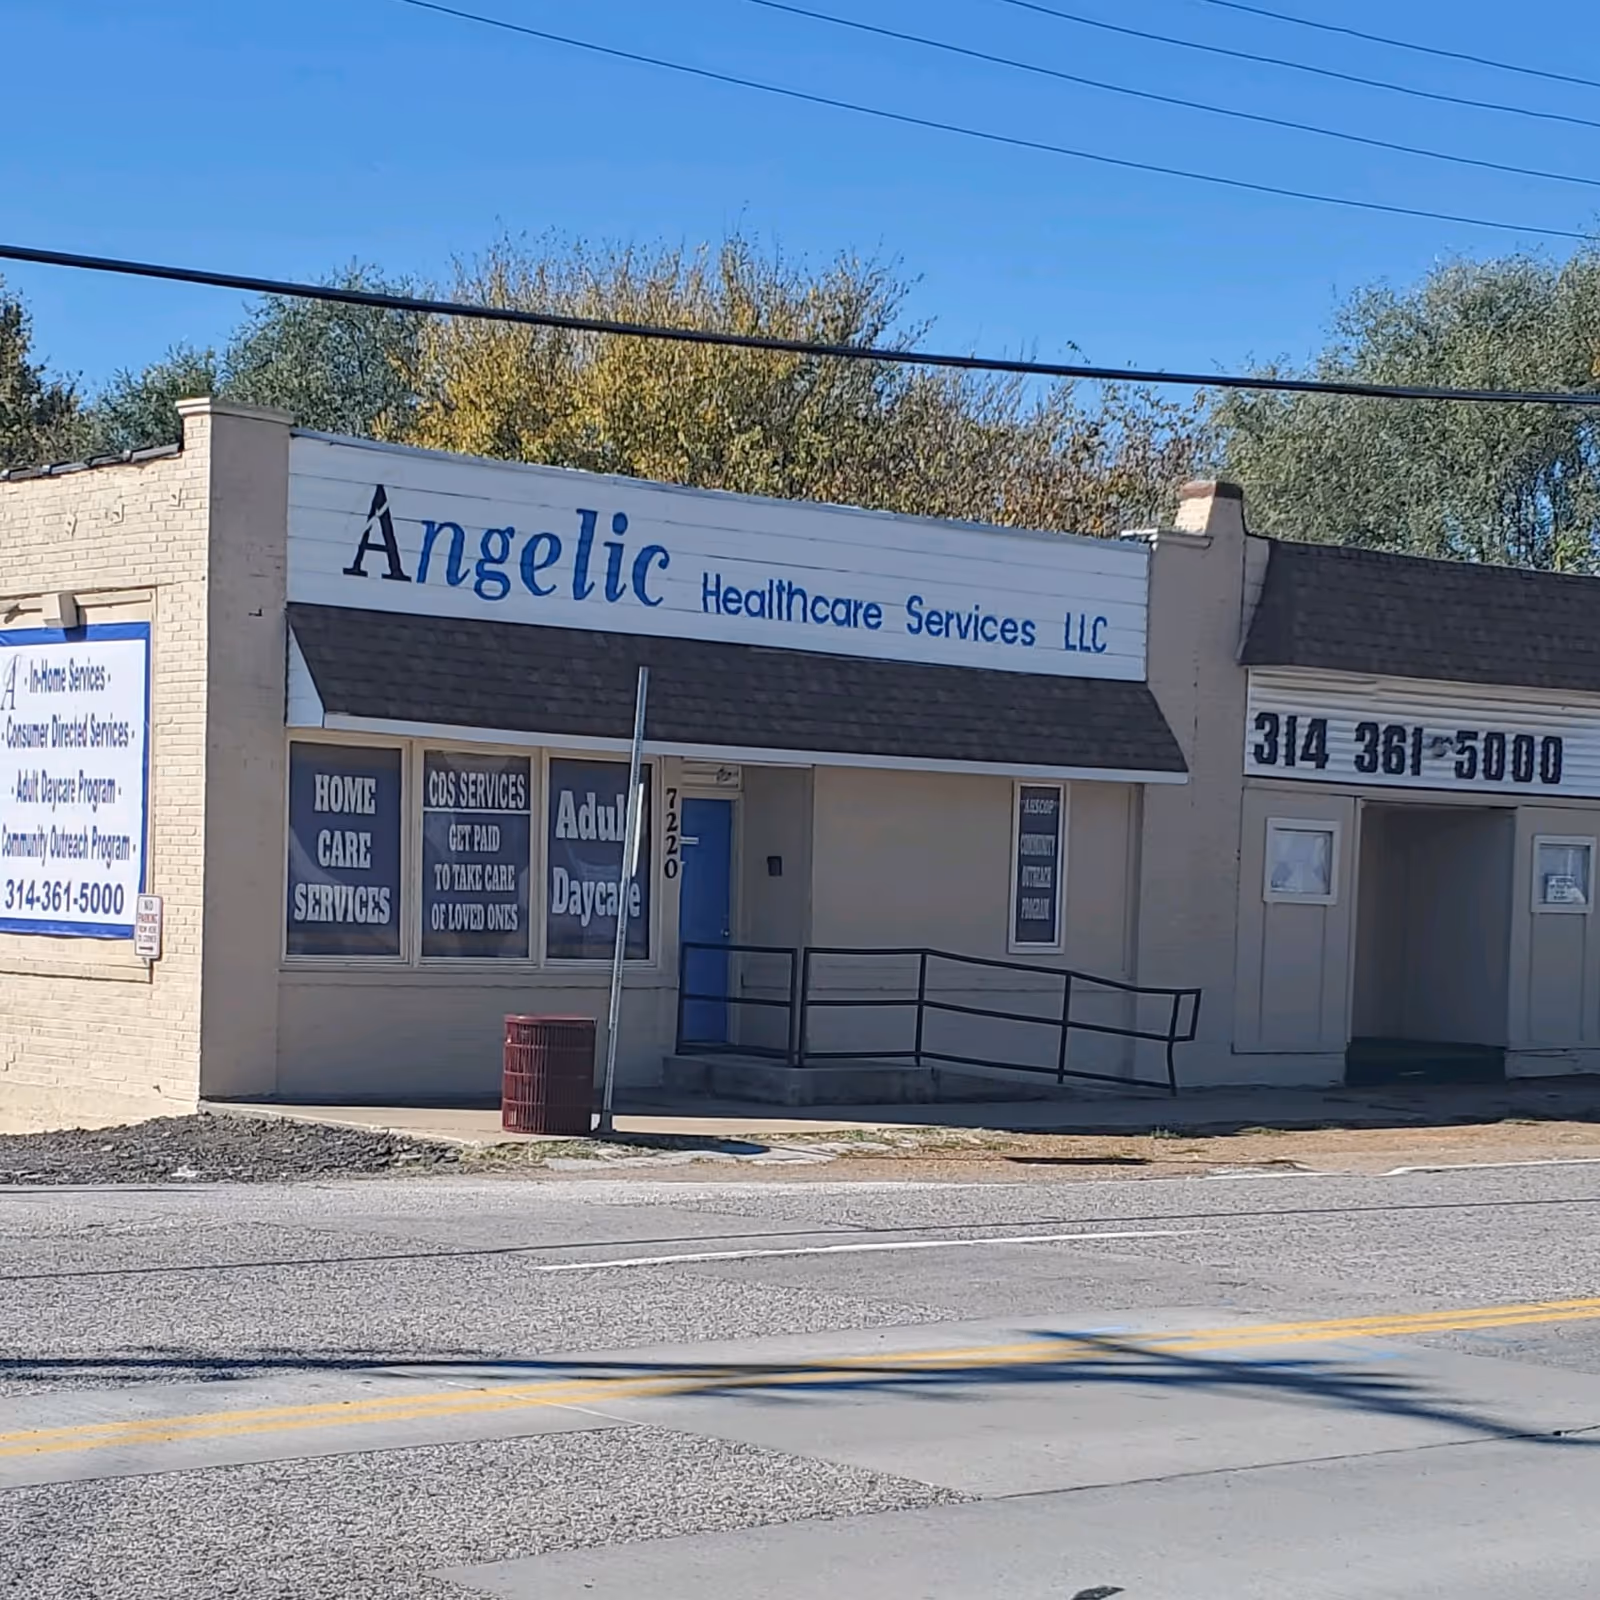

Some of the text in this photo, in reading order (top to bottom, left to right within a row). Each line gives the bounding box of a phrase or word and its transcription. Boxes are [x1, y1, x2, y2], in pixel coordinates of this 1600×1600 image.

[343, 484, 1108, 654] Angelic Healthcare Services LLC
[29, 658, 106, 694] In-Home Services
[6, 713, 129, 749] Consumer Directed Services
[1253, 712, 1563, 785] 314 361 5000
[16, 769, 116, 813] Adult Daycare Program
[314, 774, 377, 815] HOME
[429, 770, 526, 810] CDS SERVICES
[555, 790, 628, 842] Adul
[1, 824, 130, 869] Community Outreach Program
[317, 829, 371, 869] CARE
[449, 824, 501, 852] GET PAID
[5, 877, 125, 916] 314-361-5000
[434, 863, 515, 892] TO TAKE CARE
[551, 867, 641, 927] Daycae
[294, 884, 391, 925] SERVICES
[431, 903, 519, 931] OF LOVED ONES
